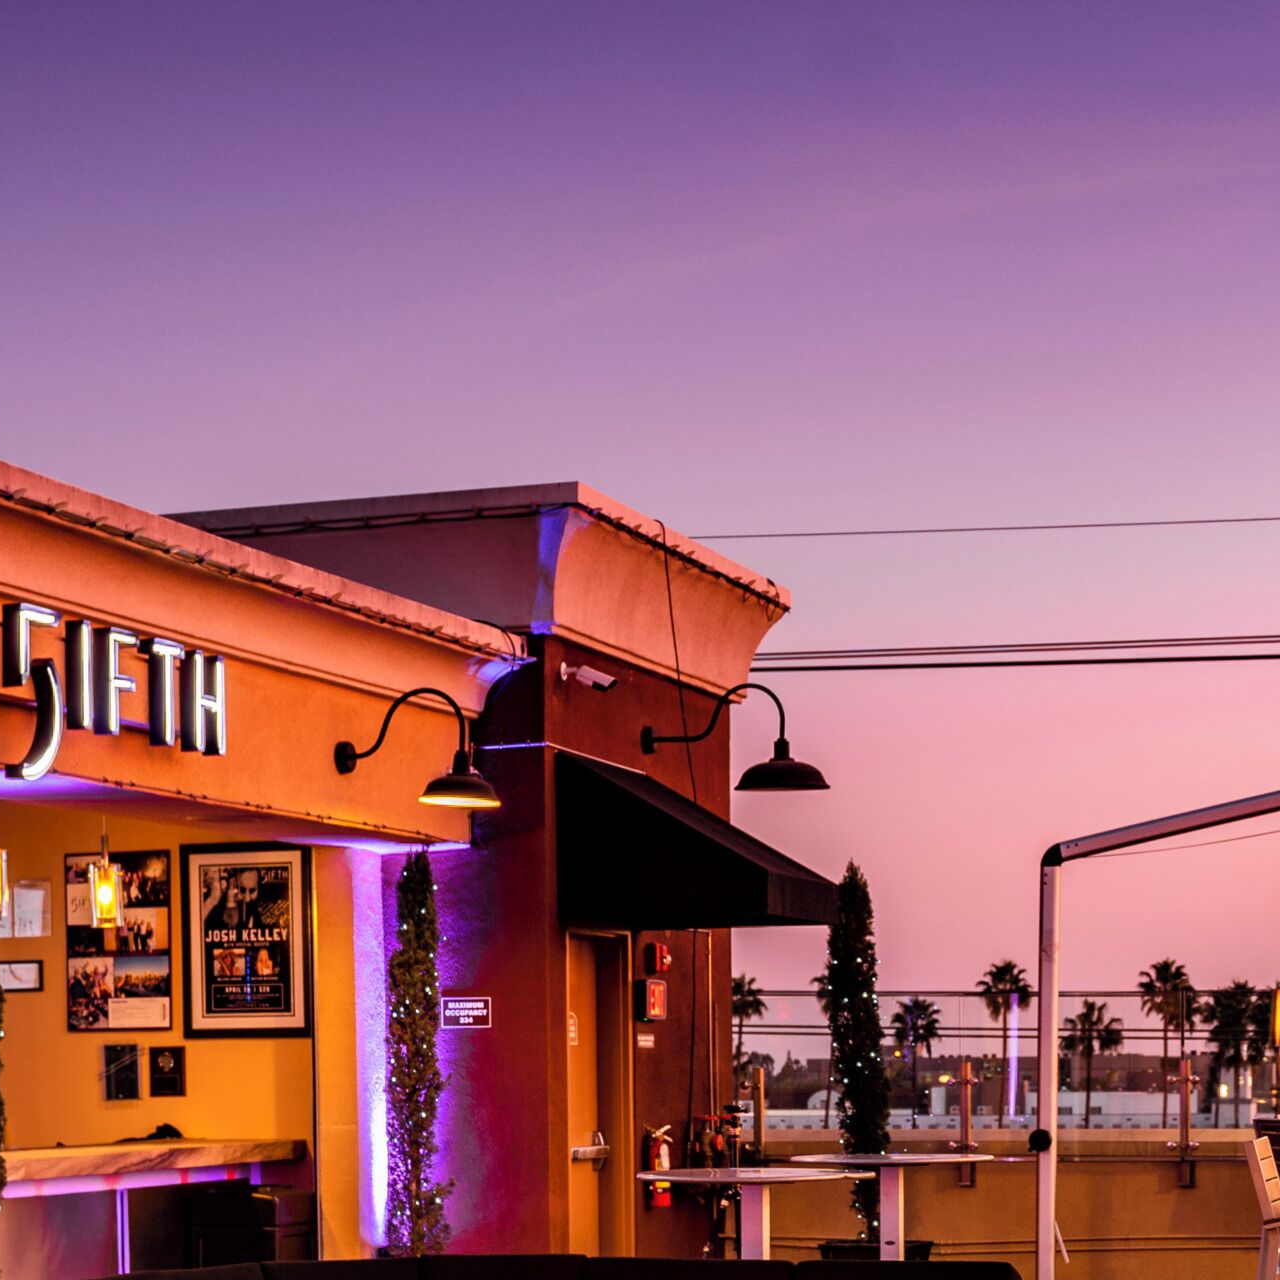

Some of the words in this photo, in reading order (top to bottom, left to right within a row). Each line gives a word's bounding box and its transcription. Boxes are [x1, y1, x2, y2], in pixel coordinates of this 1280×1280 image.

[205, 929, 237, 942] JOSH
[242, 928, 288, 941] KELLEY
[447, 1001, 485, 1009] MAXIMUM
[445, 1009, 488, 1017] OCCUPANCY
